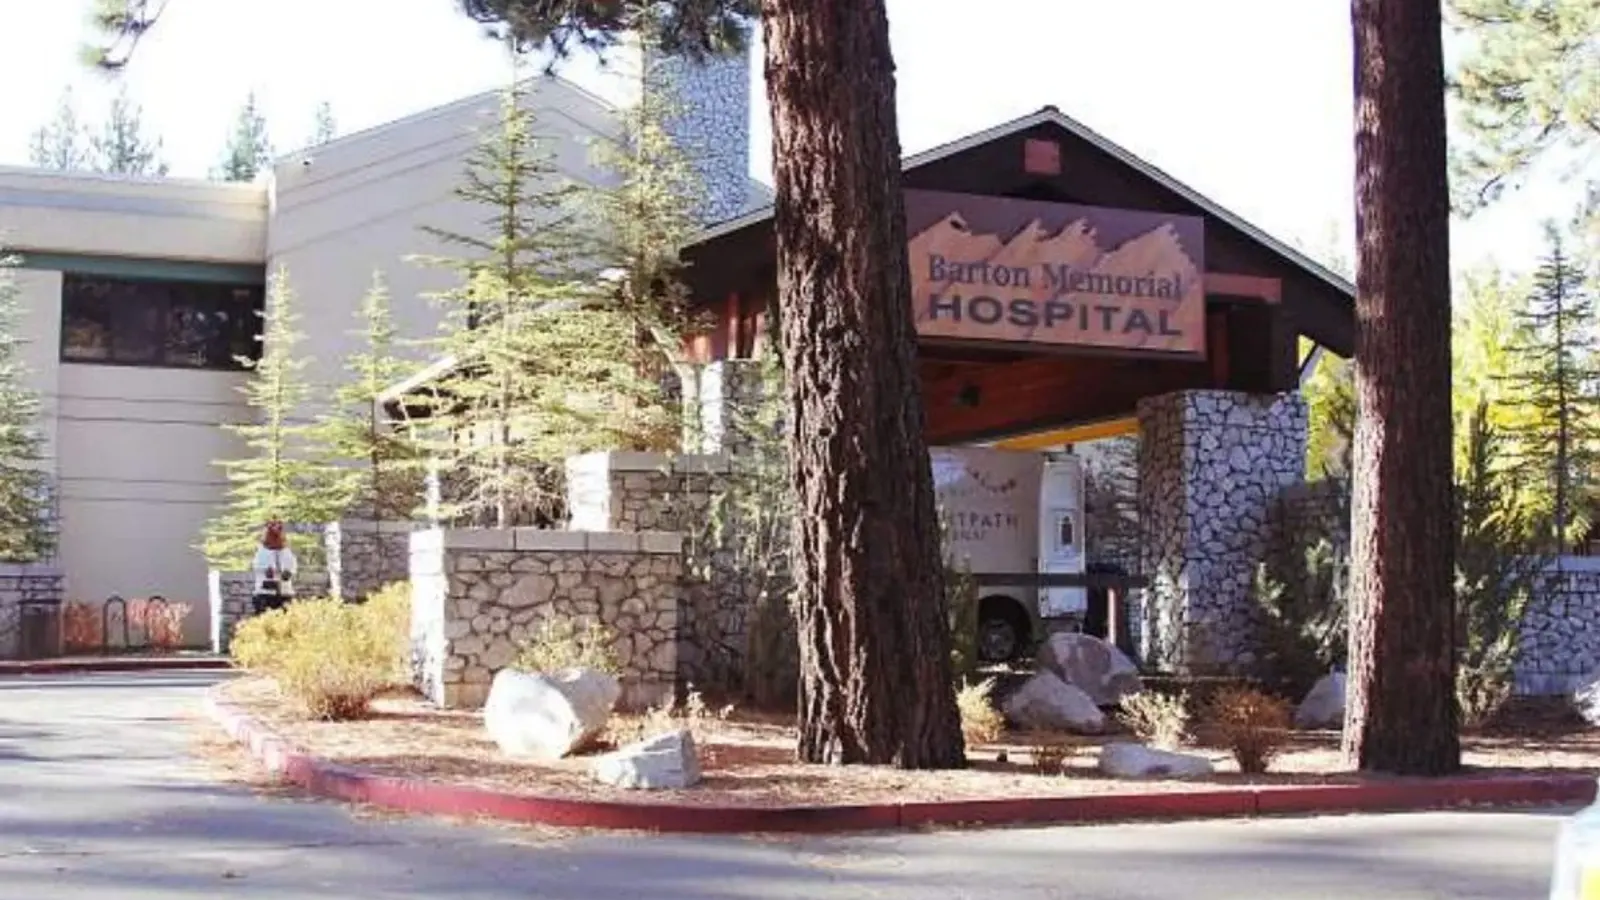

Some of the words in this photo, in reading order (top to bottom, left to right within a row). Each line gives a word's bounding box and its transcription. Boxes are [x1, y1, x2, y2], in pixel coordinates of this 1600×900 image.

[929, 254, 1029, 289] Barton
[1041, 263, 1183, 301] Memorial
[929, 293, 1184, 337] HOSPITAL
